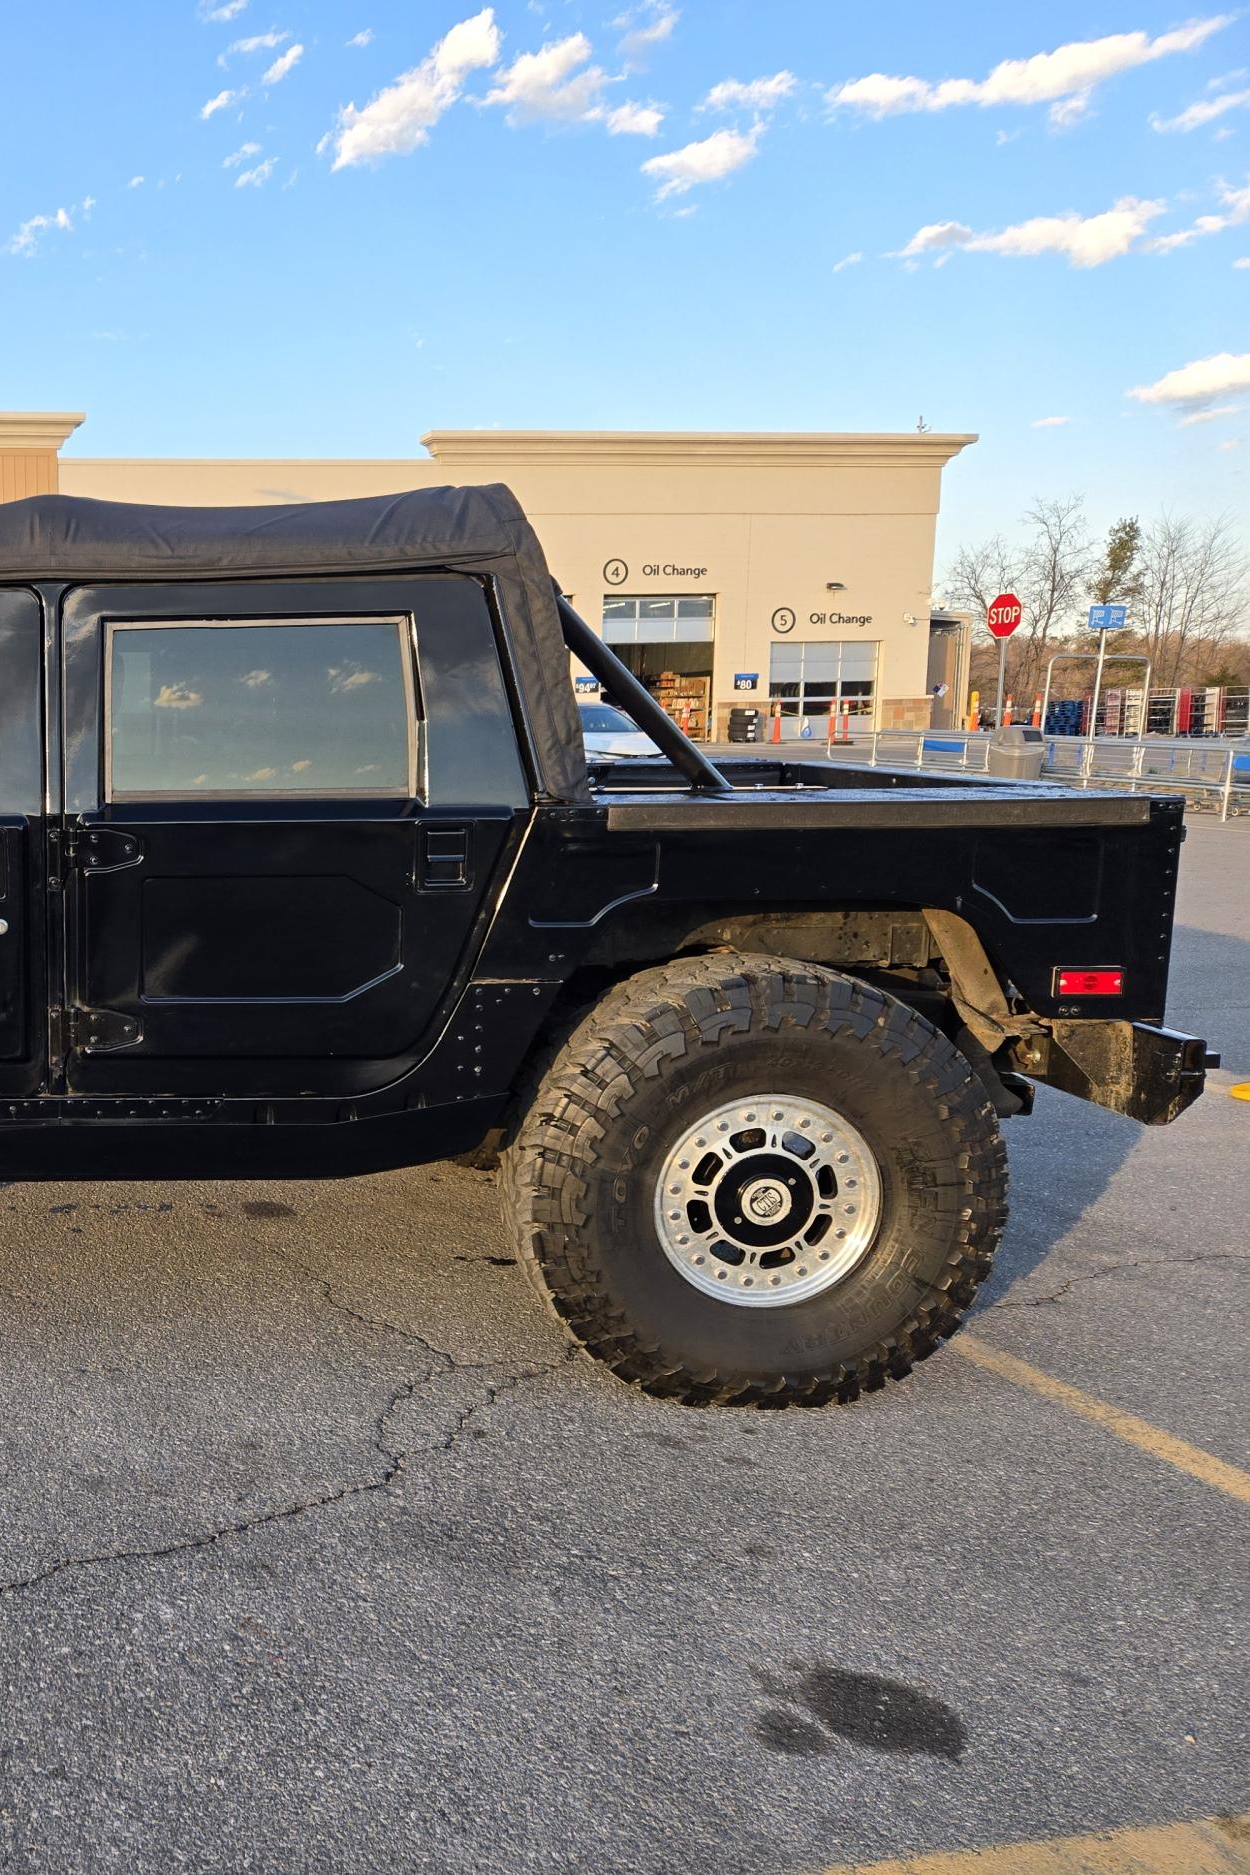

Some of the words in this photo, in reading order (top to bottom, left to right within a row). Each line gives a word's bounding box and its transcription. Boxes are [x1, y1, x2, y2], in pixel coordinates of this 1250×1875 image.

[611, 566, 621, 578] 4
[642, 564, 660, 576] Oil
[662, 563, 708, 579] Change
[779, 614, 788, 627] 5
[809, 612, 826, 625] Oil
[829, 612, 873, 627] Change
[989, 606, 1020, 625] STOP
[611, 1124, 650, 1233] TOYO
[755, 1191, 778, 1212] CTIS
